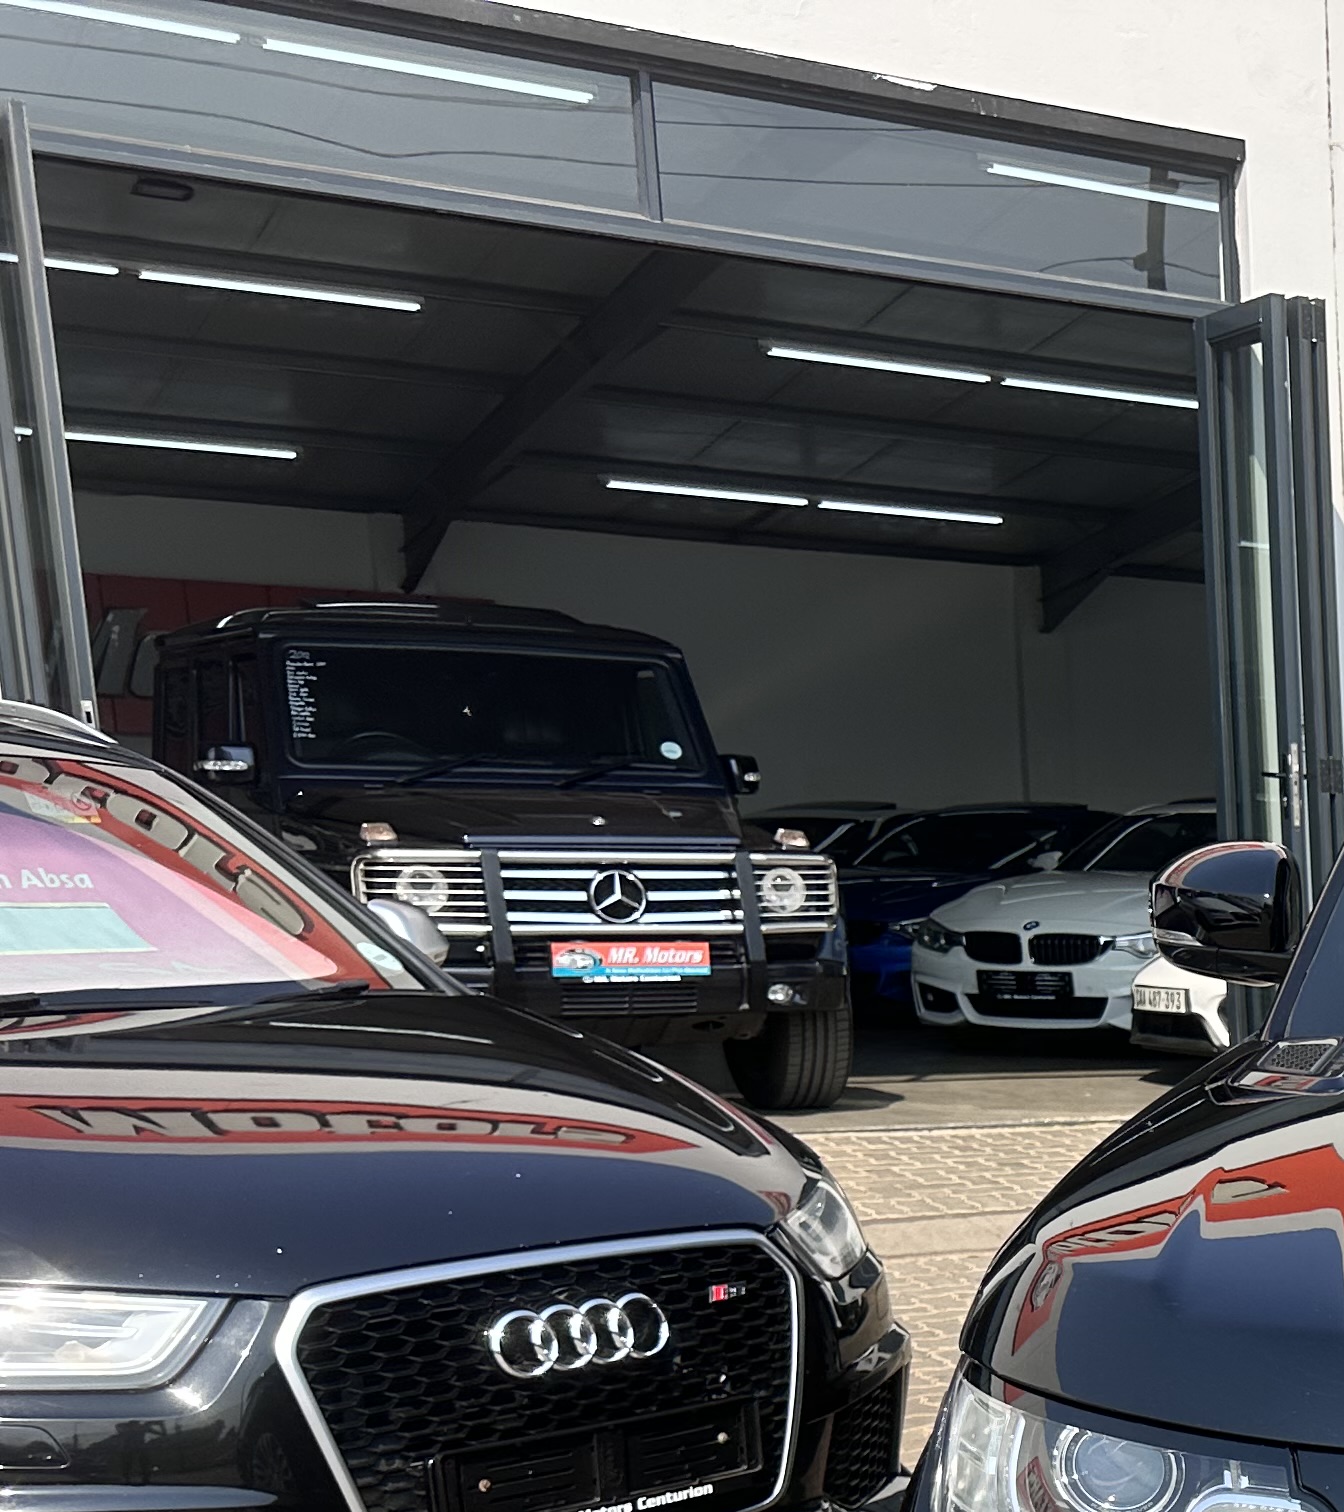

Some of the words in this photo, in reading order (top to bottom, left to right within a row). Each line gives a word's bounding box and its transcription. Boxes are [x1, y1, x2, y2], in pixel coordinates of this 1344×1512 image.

[22, 868, 94, 890] Absa
[607, 947, 640, 964] MR.
[643, 946, 704, 964] Motors
[636, 1484, 714, 1510] Centurion
